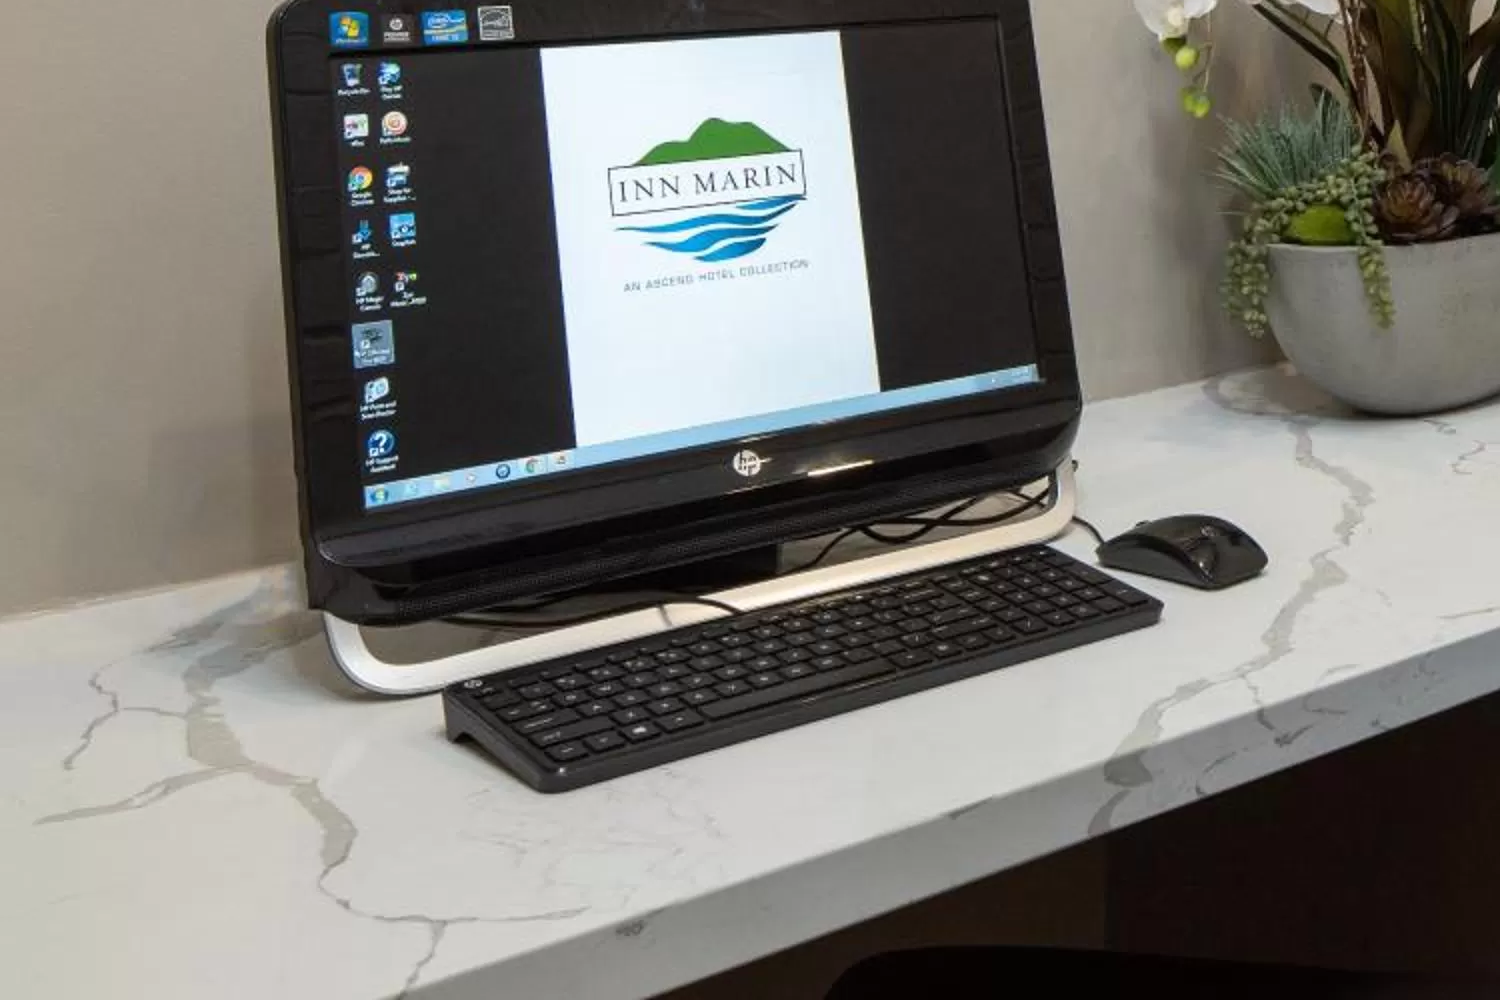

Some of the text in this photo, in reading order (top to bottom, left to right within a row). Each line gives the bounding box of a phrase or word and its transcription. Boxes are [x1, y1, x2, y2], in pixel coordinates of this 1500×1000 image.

[619, 163, 797, 202] INN MARIN
[623, 259, 809, 293] AN ASCEND HOTEL COLLECTION
